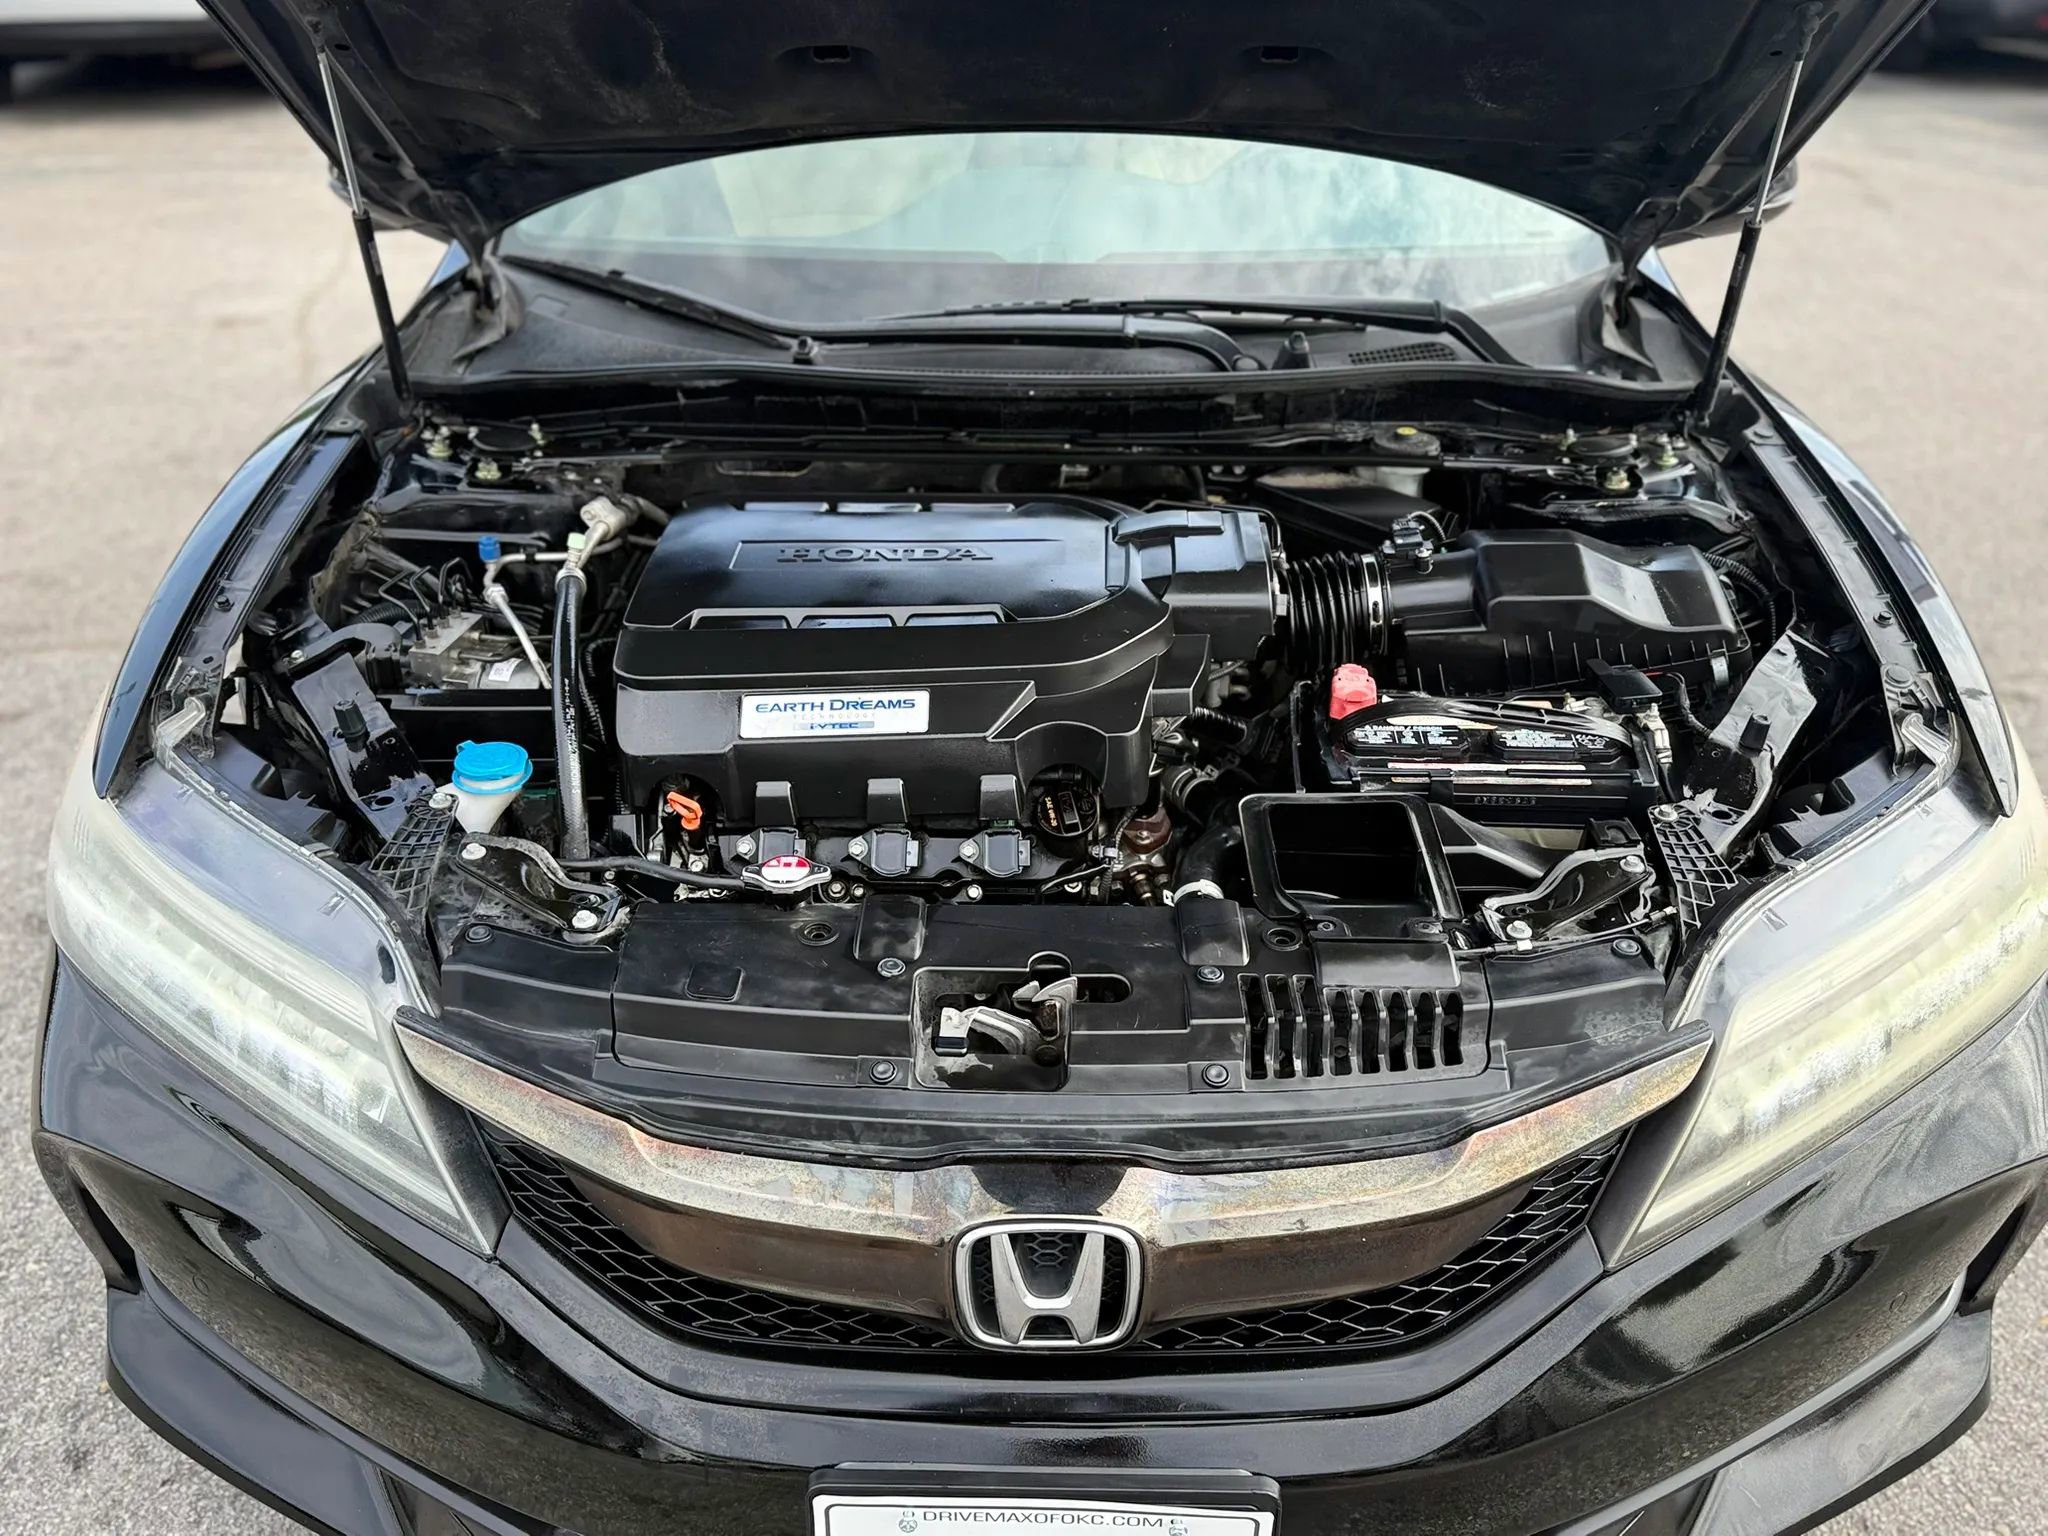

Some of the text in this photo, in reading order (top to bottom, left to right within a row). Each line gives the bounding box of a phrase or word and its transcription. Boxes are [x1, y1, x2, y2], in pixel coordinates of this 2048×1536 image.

[777, 547, 993, 563] HONDA
[755, 698, 916, 713] EARTH DREAMS
[923, 1510, 1163, 1527] DRIVEMAXOFOKC.COM
